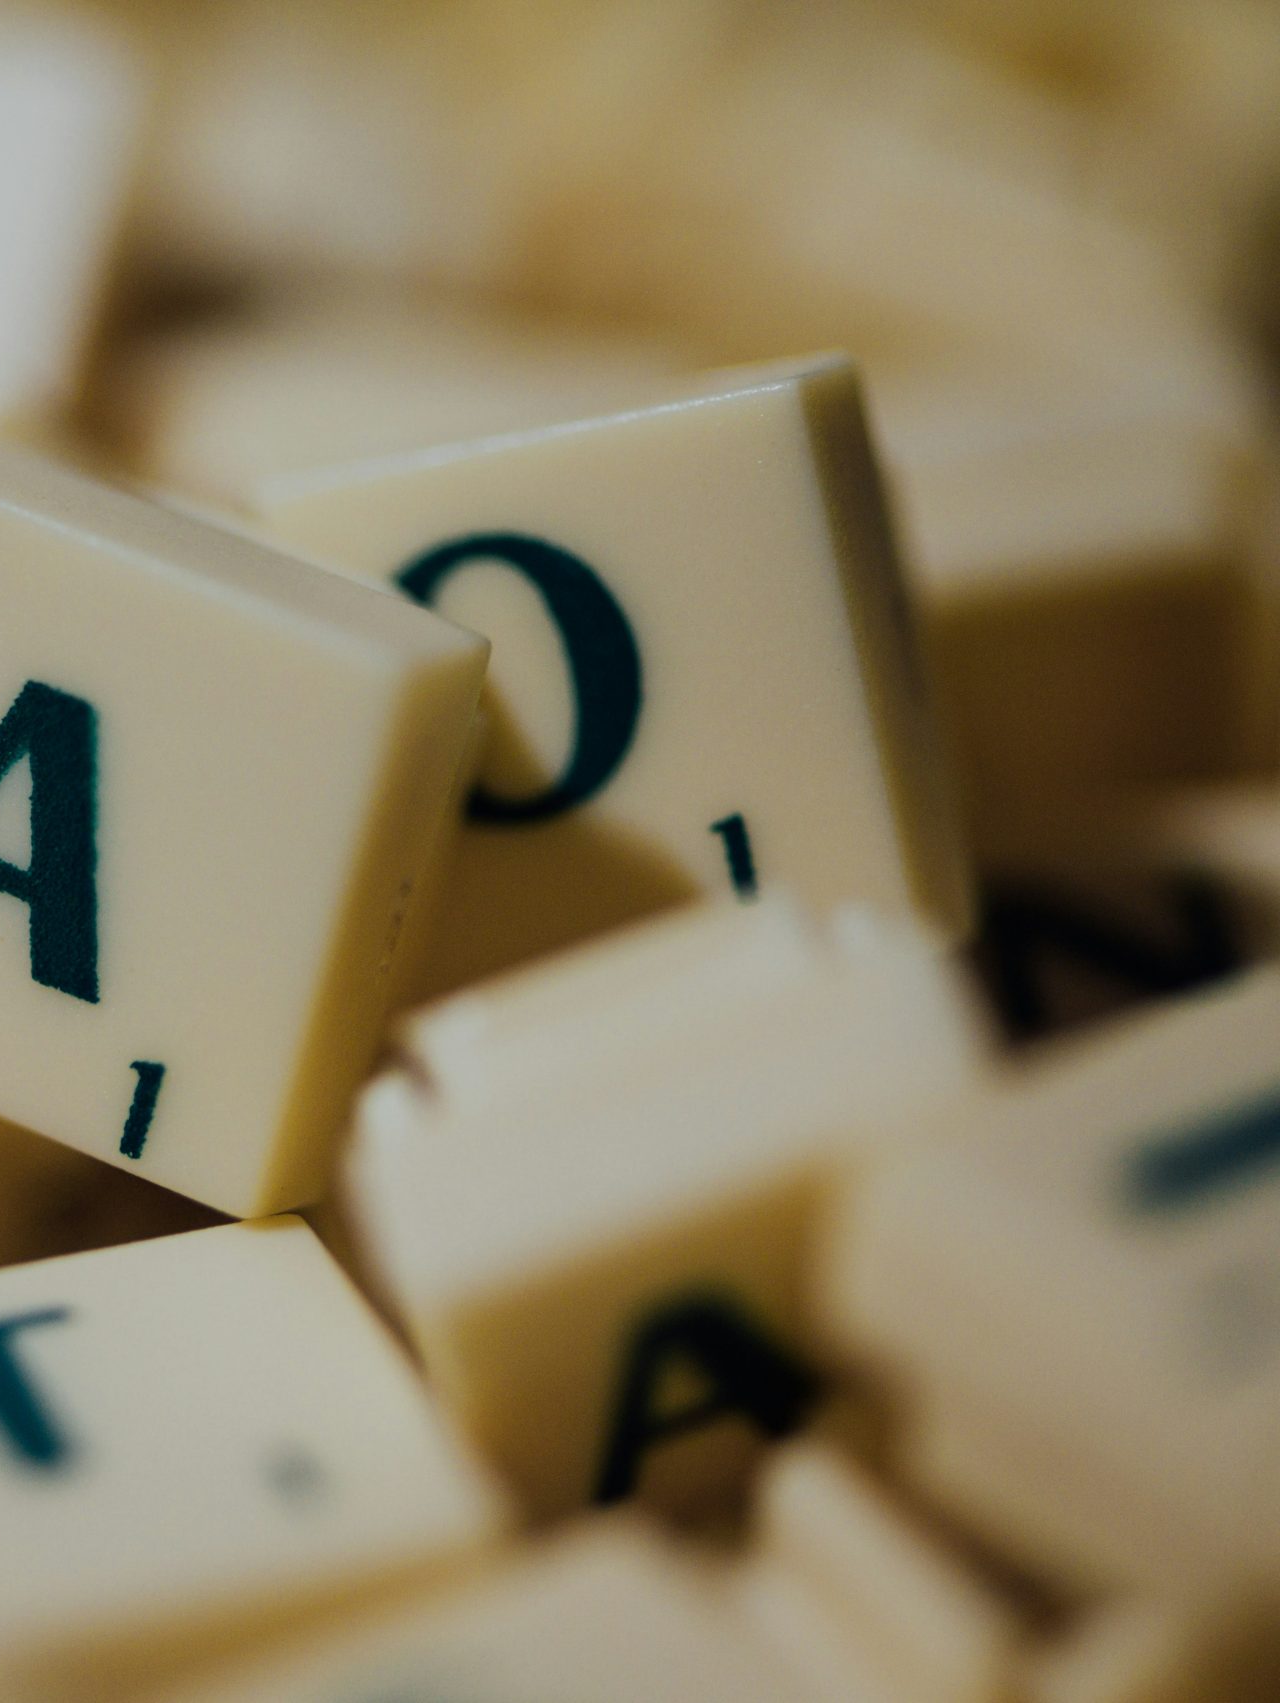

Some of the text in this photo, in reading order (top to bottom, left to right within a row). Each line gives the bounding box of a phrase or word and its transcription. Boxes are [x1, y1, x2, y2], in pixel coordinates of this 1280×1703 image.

[394, 531, 644, 826] O
[709, 811, 758, 902] 1
[118, 1060, 166, 1160] 1
[588, 1280, 822, 1508] A
